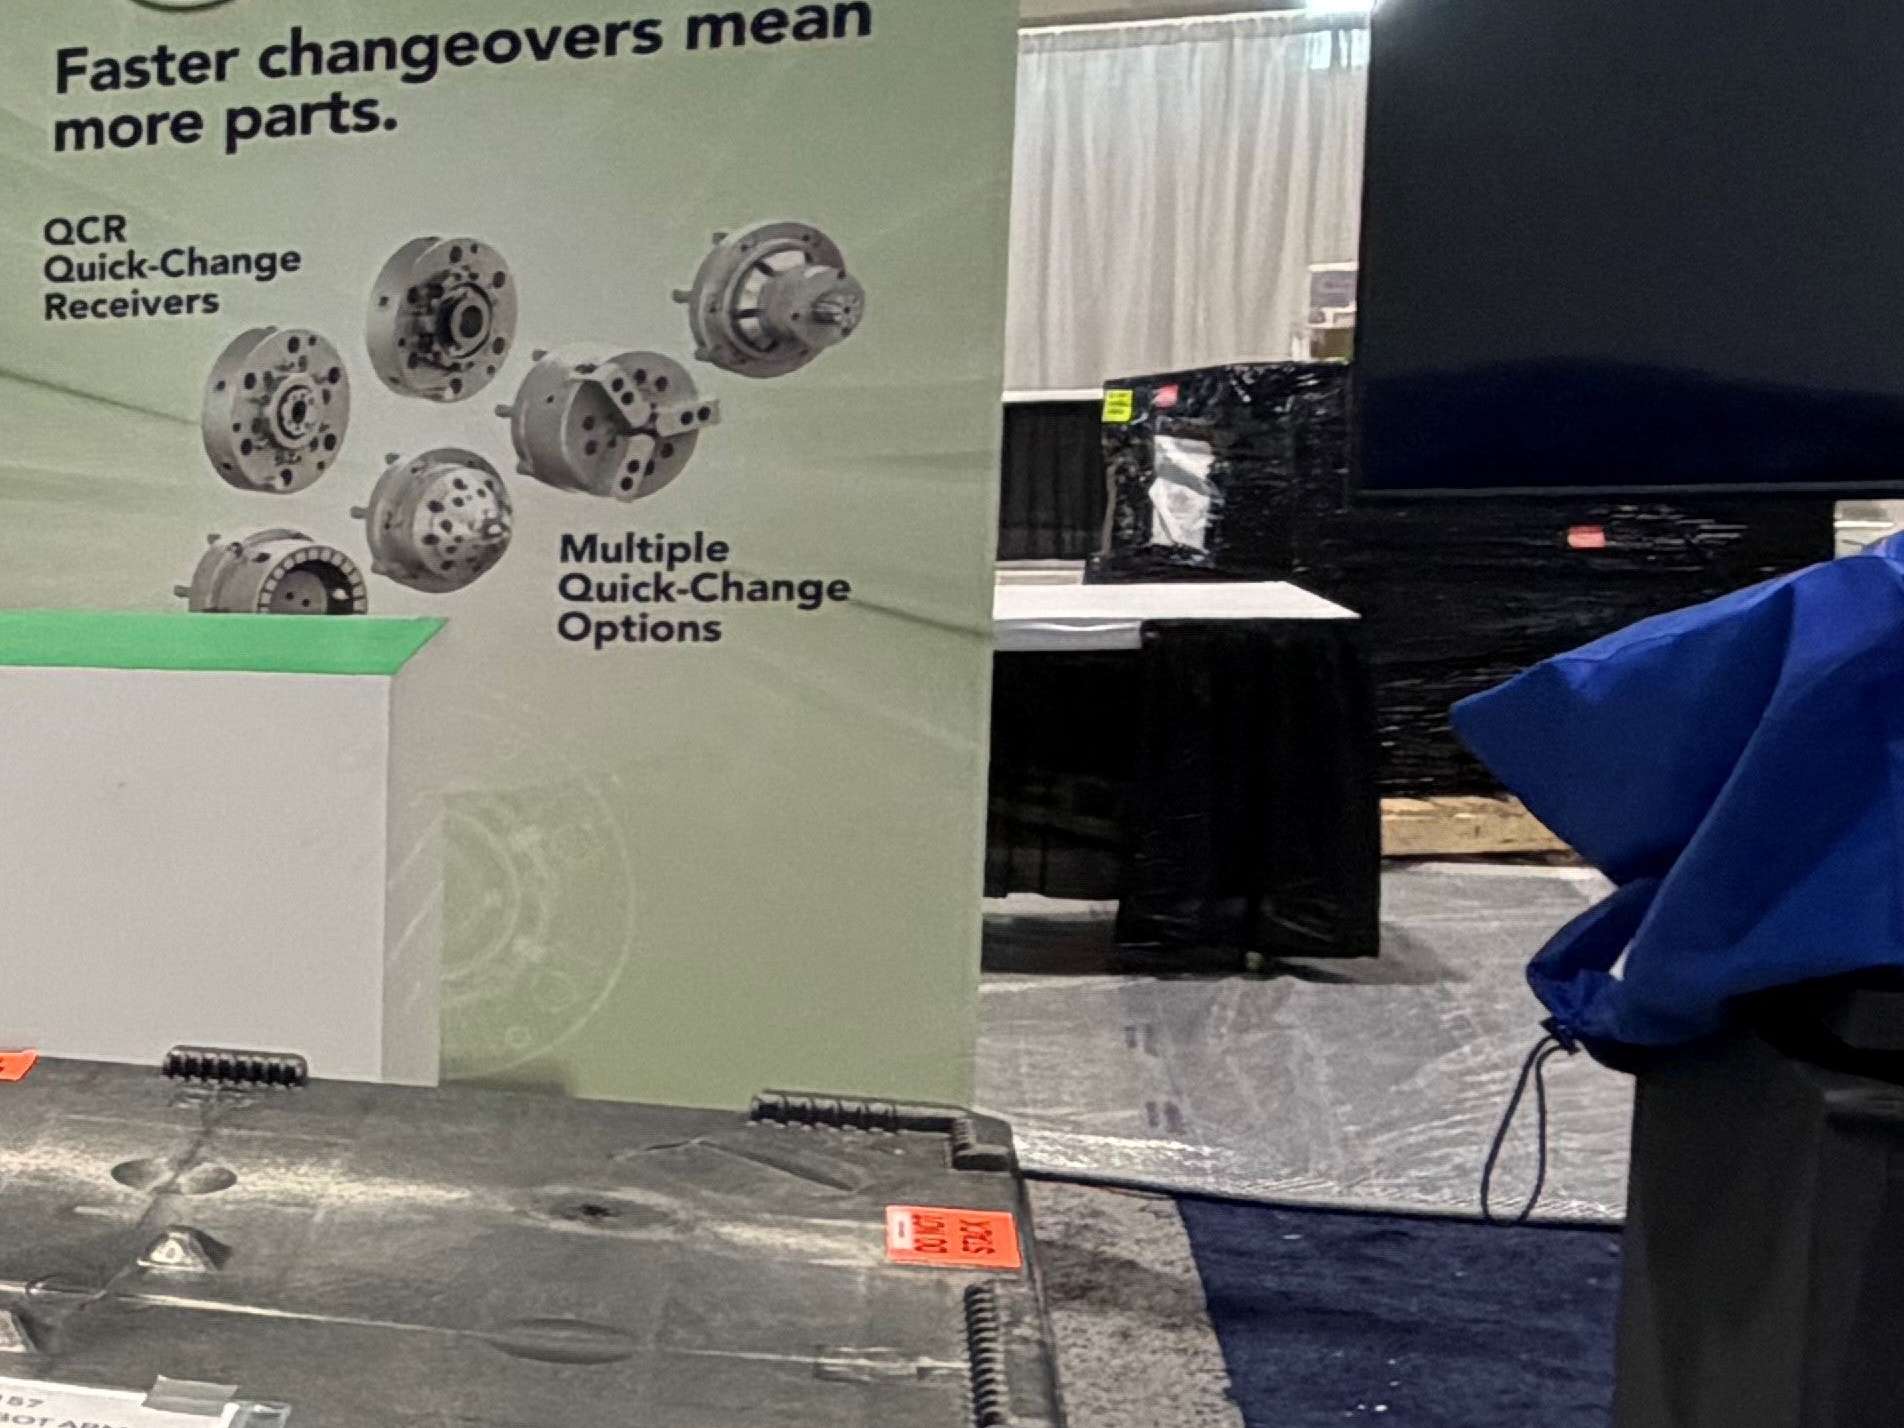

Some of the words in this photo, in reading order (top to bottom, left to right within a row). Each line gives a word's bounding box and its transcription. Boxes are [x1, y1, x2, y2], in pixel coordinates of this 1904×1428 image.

[57, 32, 242, 94] Faster
[258, 17, 664, 84] changeovers
[684, 0, 874, 52] mean
[54, 102, 204, 152] more
[224, 88, 400, 154] parts.
[43, 214, 129, 246] QCR
[42, 245, 302, 286] Quick-Change
[43, 297, 221, 321] Receivers
[560, 530, 730, 572] Multiple
[558, 570, 852, 614] Quick-Change
[557, 610, 724, 652] Options
[914, 1238, 948, 1253] DO
[959, 1218, 995, 1254] STACK
